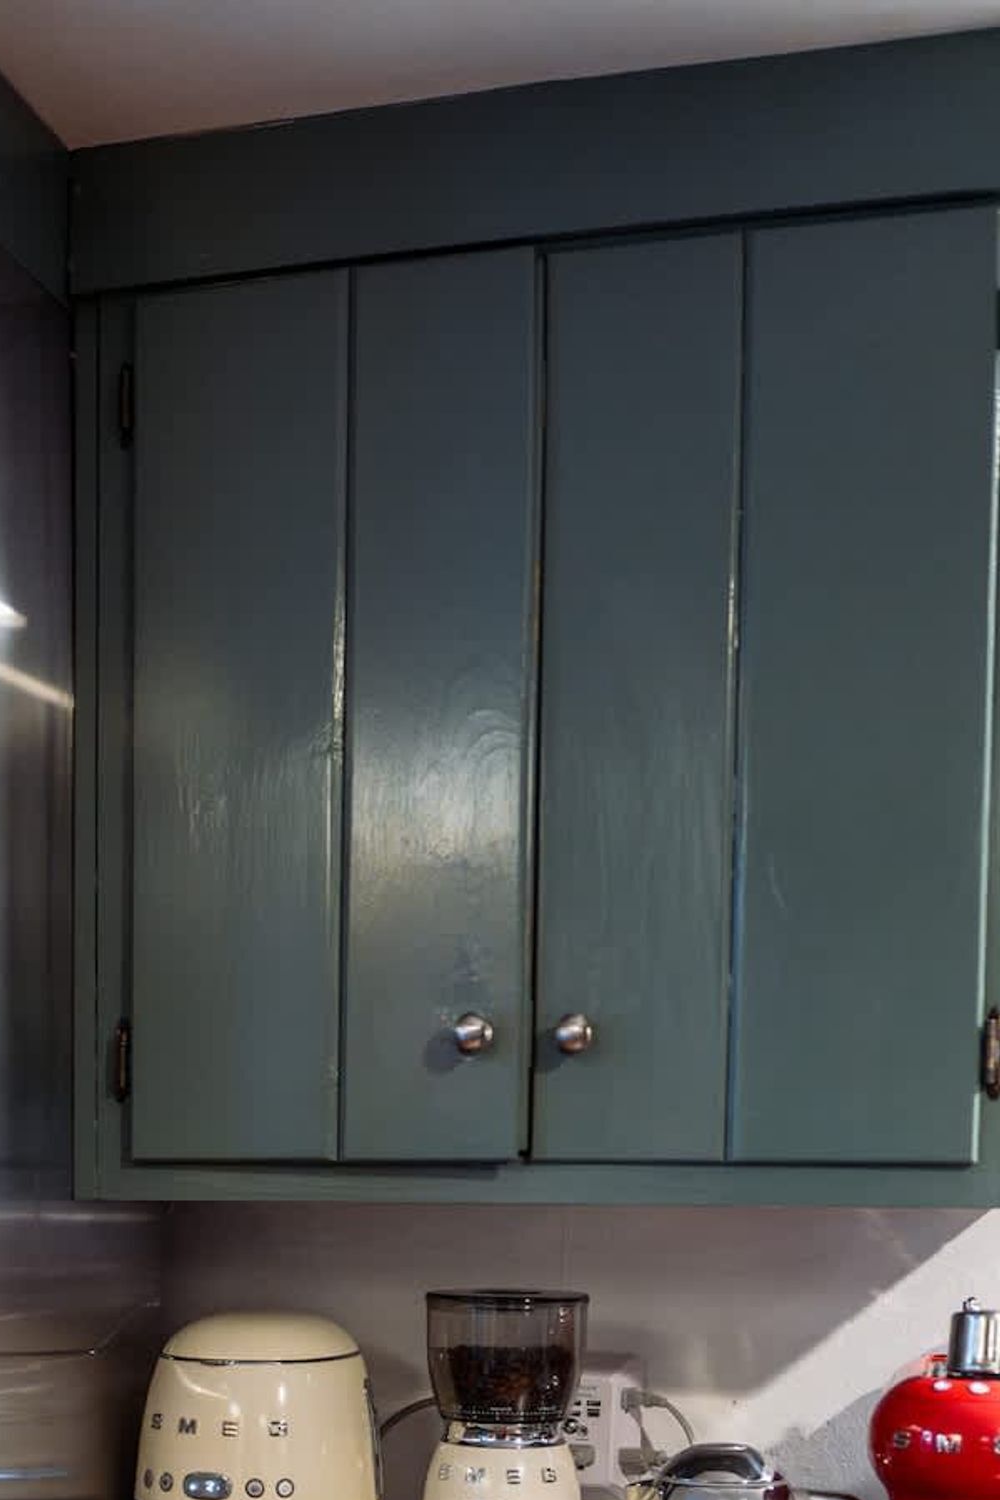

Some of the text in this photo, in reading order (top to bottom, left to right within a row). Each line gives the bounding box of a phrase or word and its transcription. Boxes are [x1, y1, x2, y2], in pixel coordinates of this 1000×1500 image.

[150, 1412, 288, 1438] SMEG
[893, 1430, 1000, 1455] SM
[438, 1464, 558, 1485] SMEG
